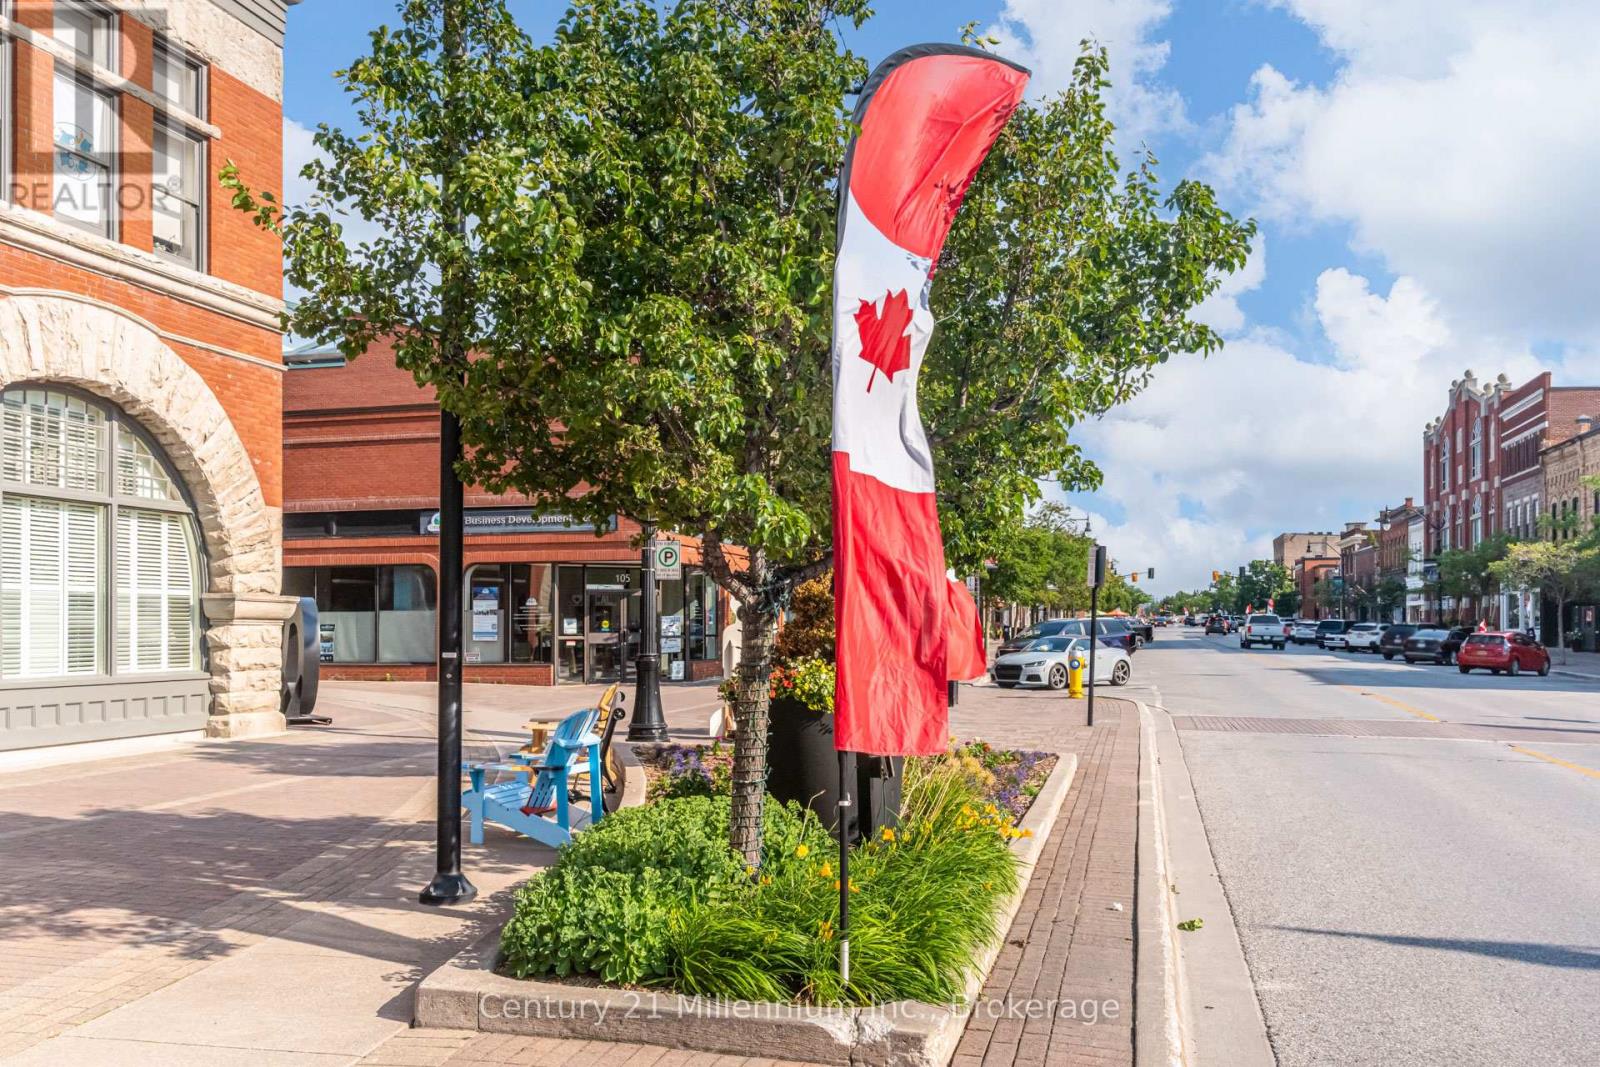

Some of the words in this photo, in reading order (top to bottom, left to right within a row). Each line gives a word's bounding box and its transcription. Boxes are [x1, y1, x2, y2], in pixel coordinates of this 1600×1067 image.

[464, 517, 506, 525] Business
[508, 514, 573, 525] Deveopment
[664, 551, 674, 563] P
[615, 574, 631, 583] 105
